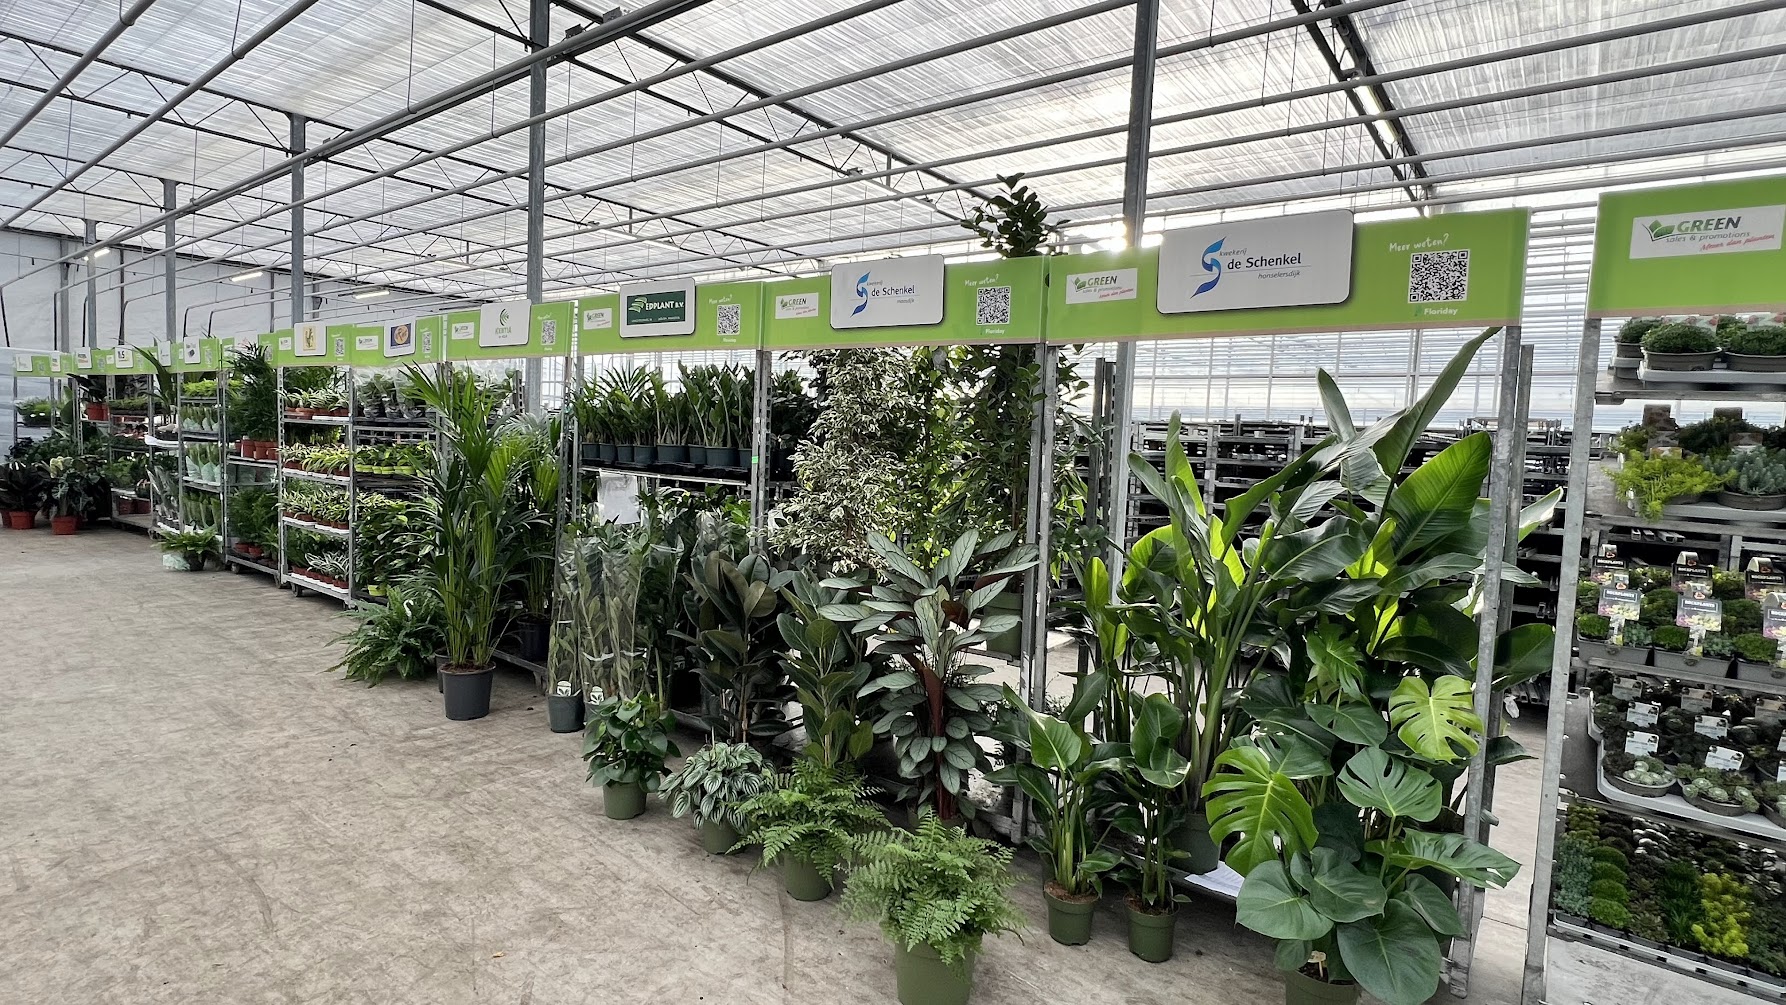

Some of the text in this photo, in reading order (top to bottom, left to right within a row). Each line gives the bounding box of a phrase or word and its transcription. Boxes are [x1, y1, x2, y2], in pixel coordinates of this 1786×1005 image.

[1677, 216, 1741, 233] GREEN
[1389, 233, 1449, 252] Meer weten?
[1666, 231, 1750, 243] sales & promotions
[1219, 247, 1247, 257] kwekerij
[1227, 252, 1301, 270] de Schenkel
[1257, 265, 1301, 280] honselersdijk
[1087, 275, 1118, 287] GREEN
[871, 284, 915, 297] de Schenkel
[645, 301, 674, 311] EDPLANT
[788, 298, 807, 306] GREEN
[1424, 307, 1458, 316] Floriday
